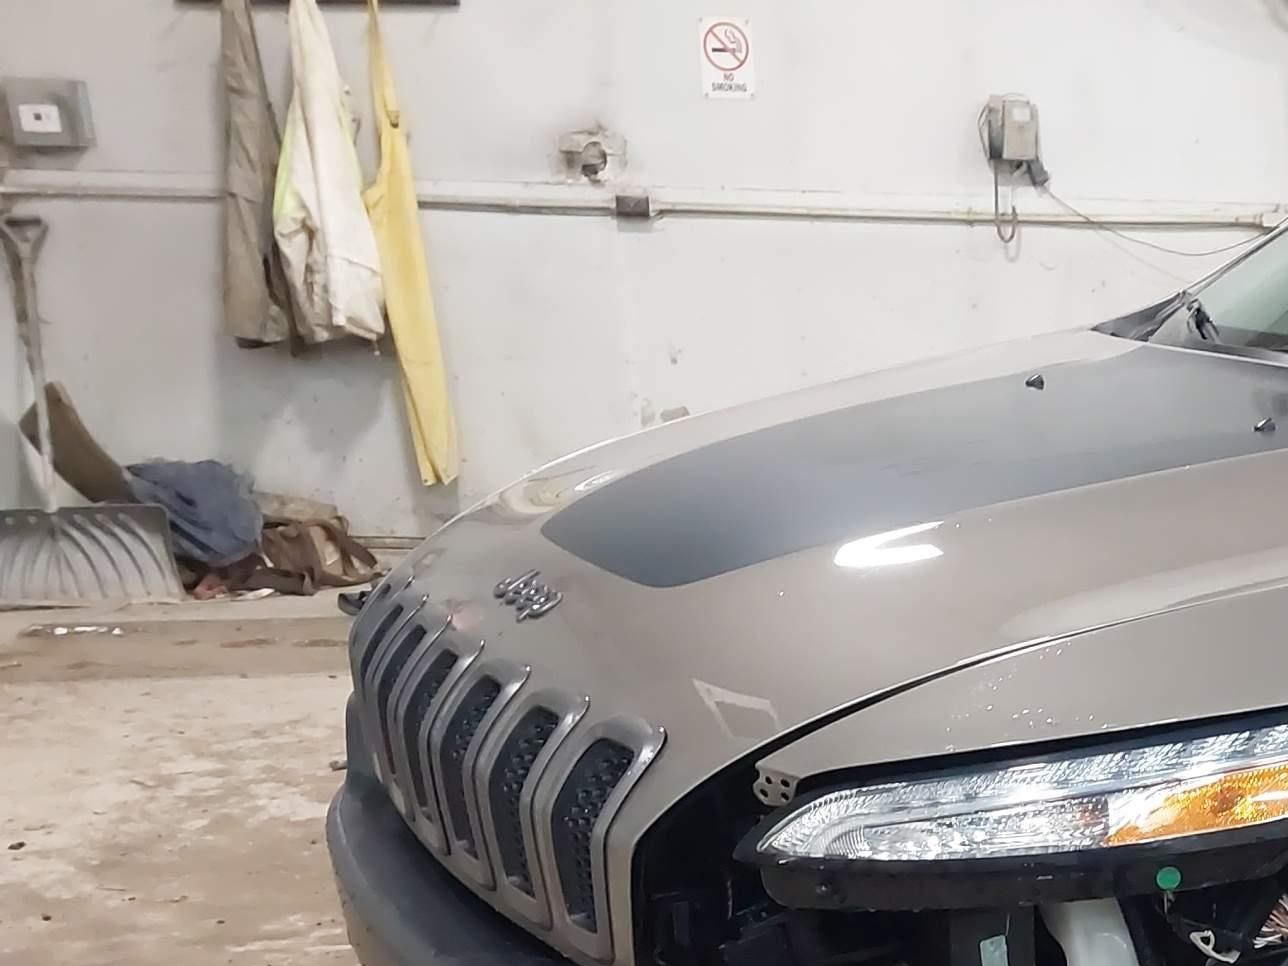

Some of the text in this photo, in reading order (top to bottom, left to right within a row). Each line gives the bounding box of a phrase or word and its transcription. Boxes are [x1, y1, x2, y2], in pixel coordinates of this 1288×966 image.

[723, 73, 735, 82] NO
[711, 82, 748, 92] SMOKING
[494, 569, 563, 624] Jeep
